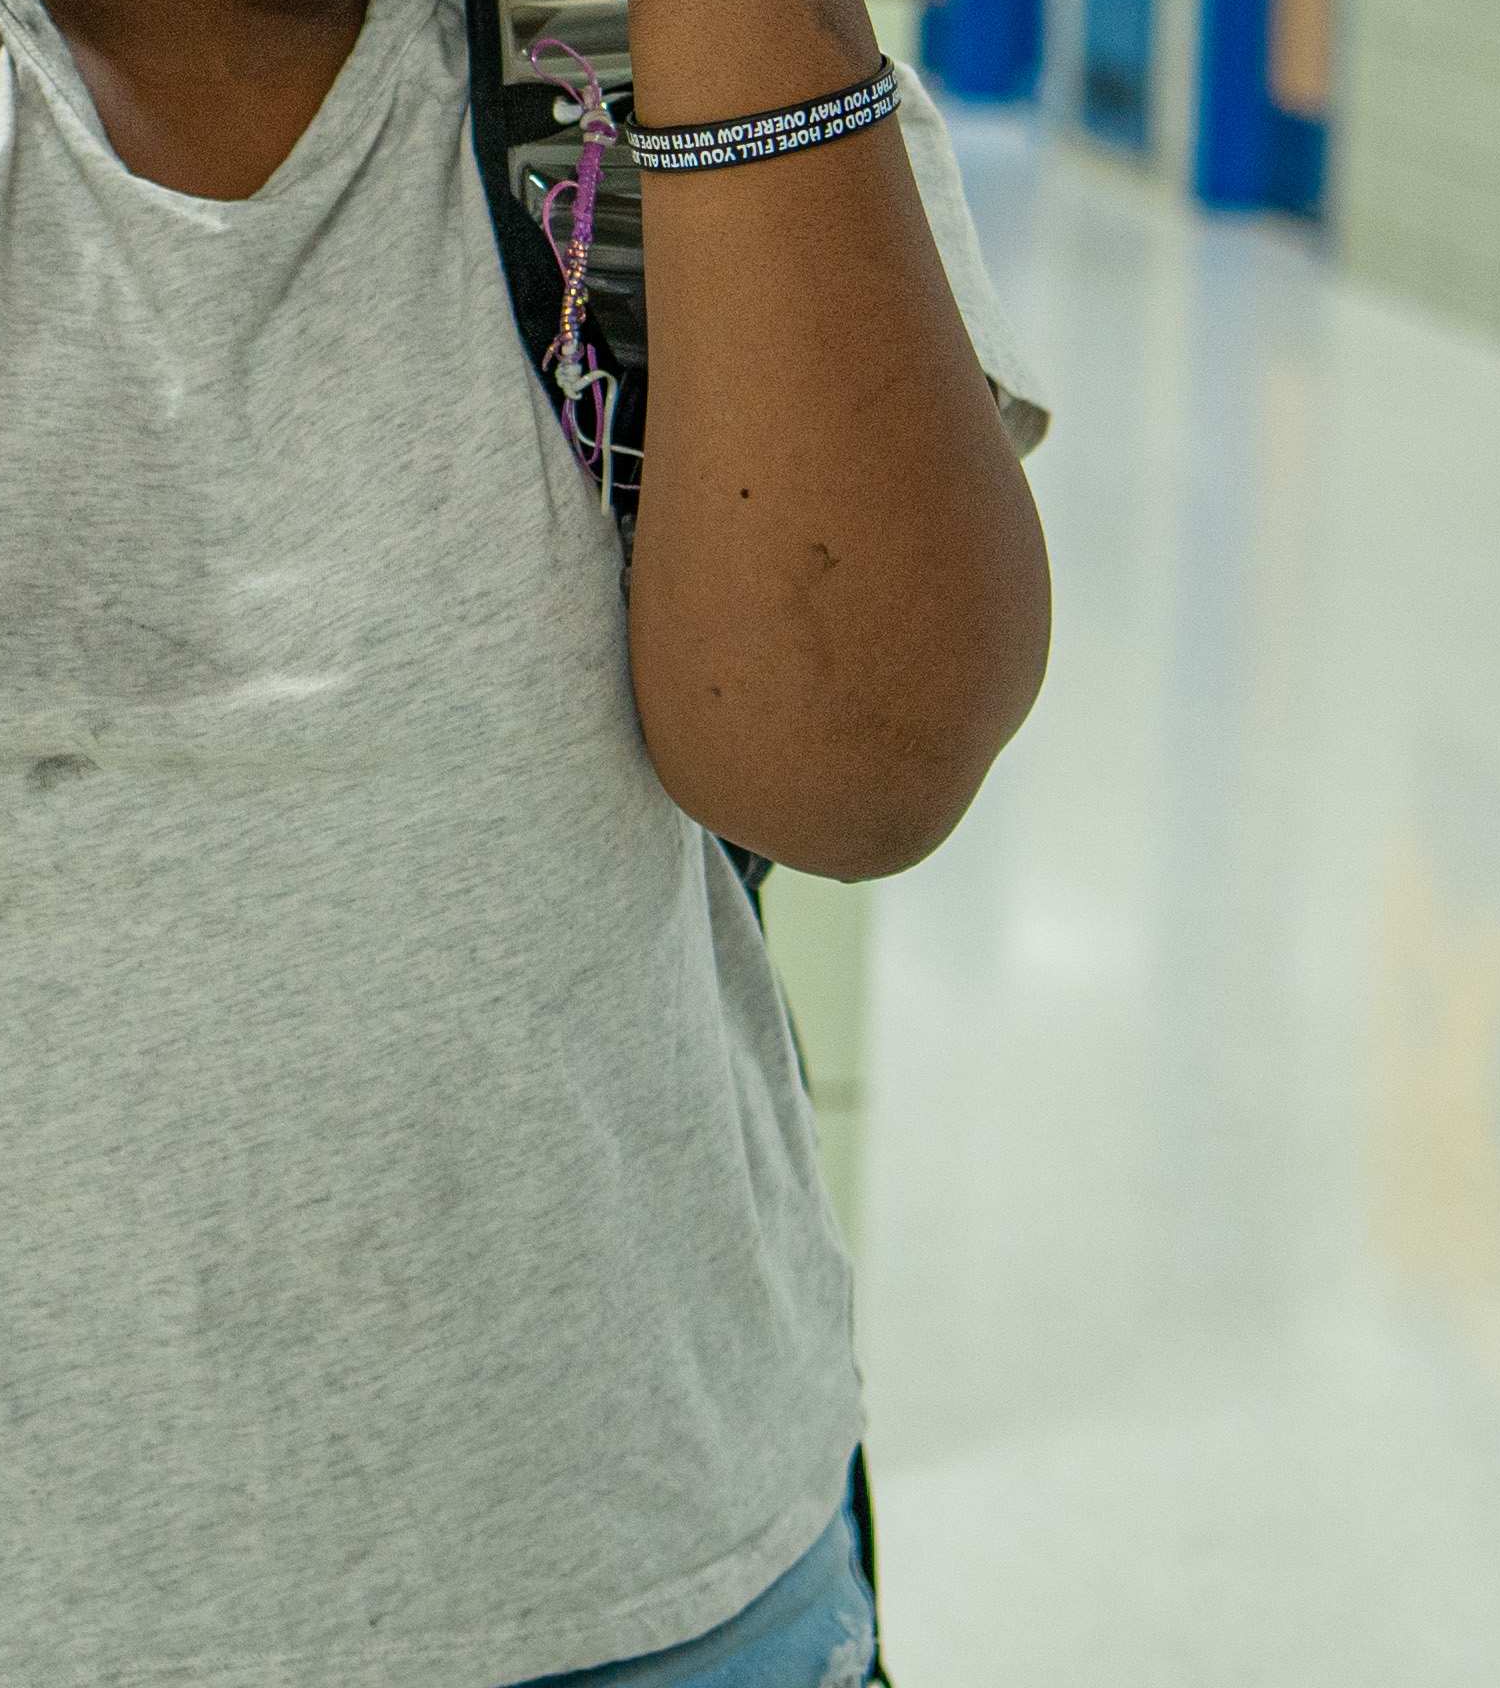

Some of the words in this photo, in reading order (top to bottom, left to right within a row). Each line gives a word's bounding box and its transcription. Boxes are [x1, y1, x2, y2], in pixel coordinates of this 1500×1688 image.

[872, 74, 894, 100] THAT
[809, 99, 842, 122] MAY
[845, 88, 870, 112] YOU
[871, 94, 894, 119] THE
[717, 111, 806, 145] OVERFLOW
[823, 118, 844, 138] OF
[845, 106, 872, 130] GOD
[640, 133, 670, 150] HOPE
[672, 130, 715, 150] WITH
[735, 136, 775, 159] FILL
[776, 125, 821, 152] HOPE
[641, 151, 660, 168] ALL
[660, 152, 699, 169] WITH
[700, 144, 735, 166] YOU
